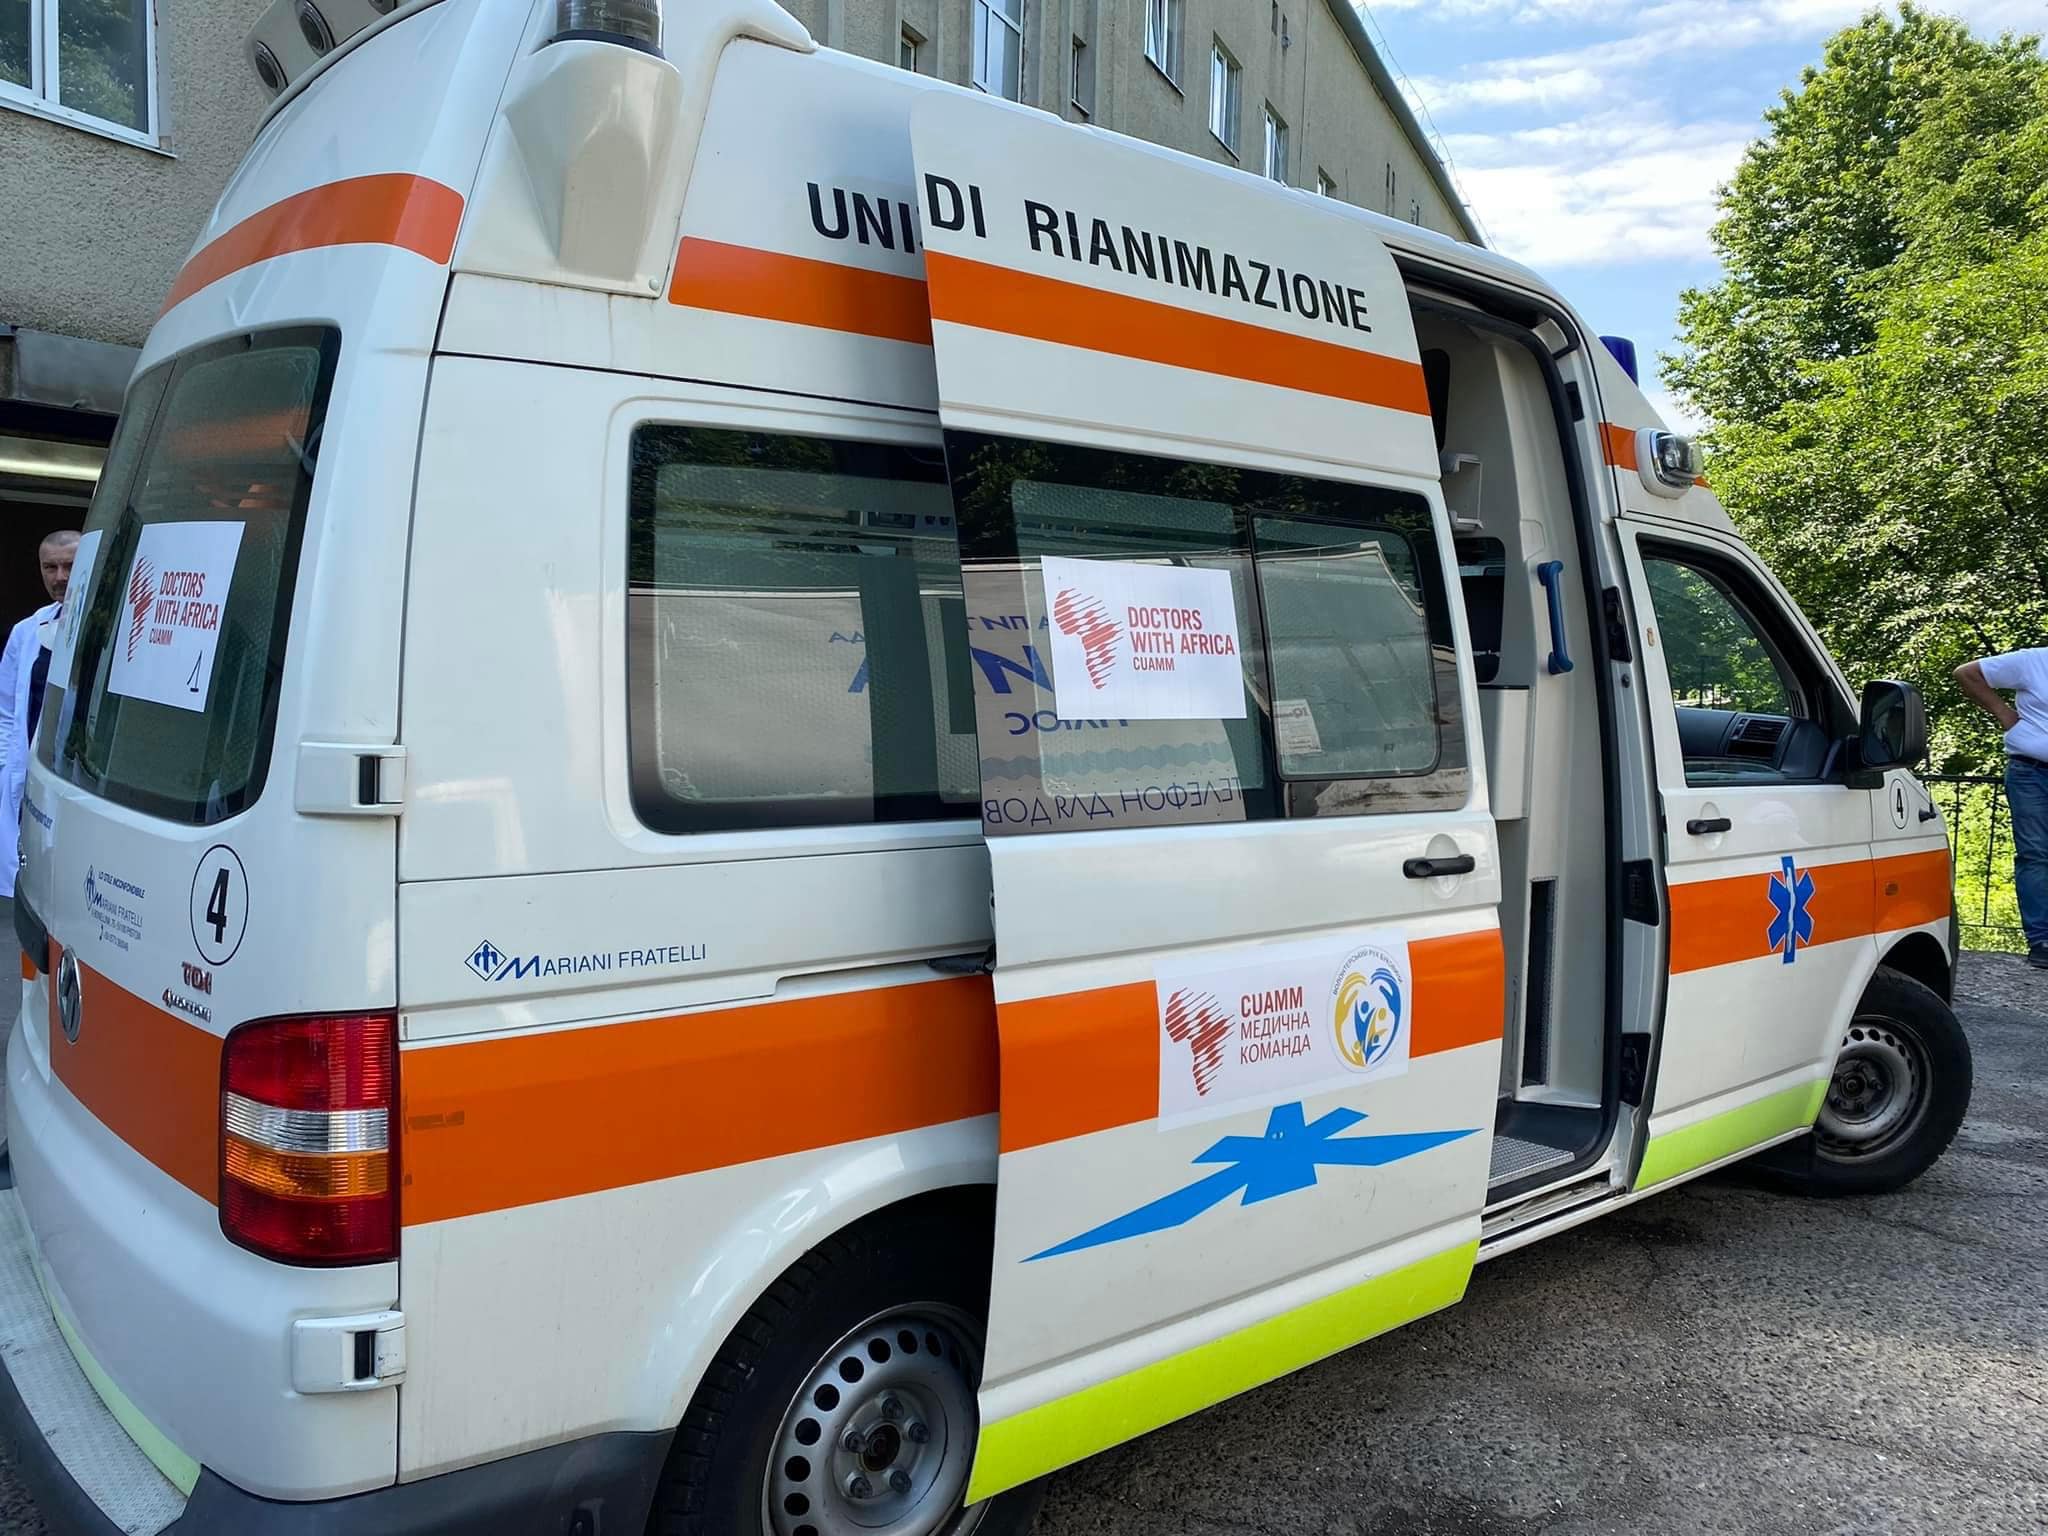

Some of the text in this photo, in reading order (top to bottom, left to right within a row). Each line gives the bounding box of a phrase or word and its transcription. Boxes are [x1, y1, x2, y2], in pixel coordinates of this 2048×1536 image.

[806, 172, 1372, 333] UNI DI RIANIMAZIONE
[159, 571, 206, 598] DOCTORS
[154, 599, 220, 631] WITH AFRICA
[1127, 606, 1202, 630] DOCTORS
[149, 628, 174, 646] CUAMM
[1130, 631, 1236, 656] WITH AFRICA
[1133, 657, 1175, 672] CUAMM
[1897, 788, 1903, 819] 4
[118, 905, 143, 927] FRATELLI
[206, 868, 230, 944] 4
[495, 944, 706, 981] MARIANI FRATELLI
[1240, 986, 1303, 1018] CUAMM
[1240, 1011, 1311, 1041] МЕДИЧНА
[1240, 1036, 1311, 1065] КОМАНДА
